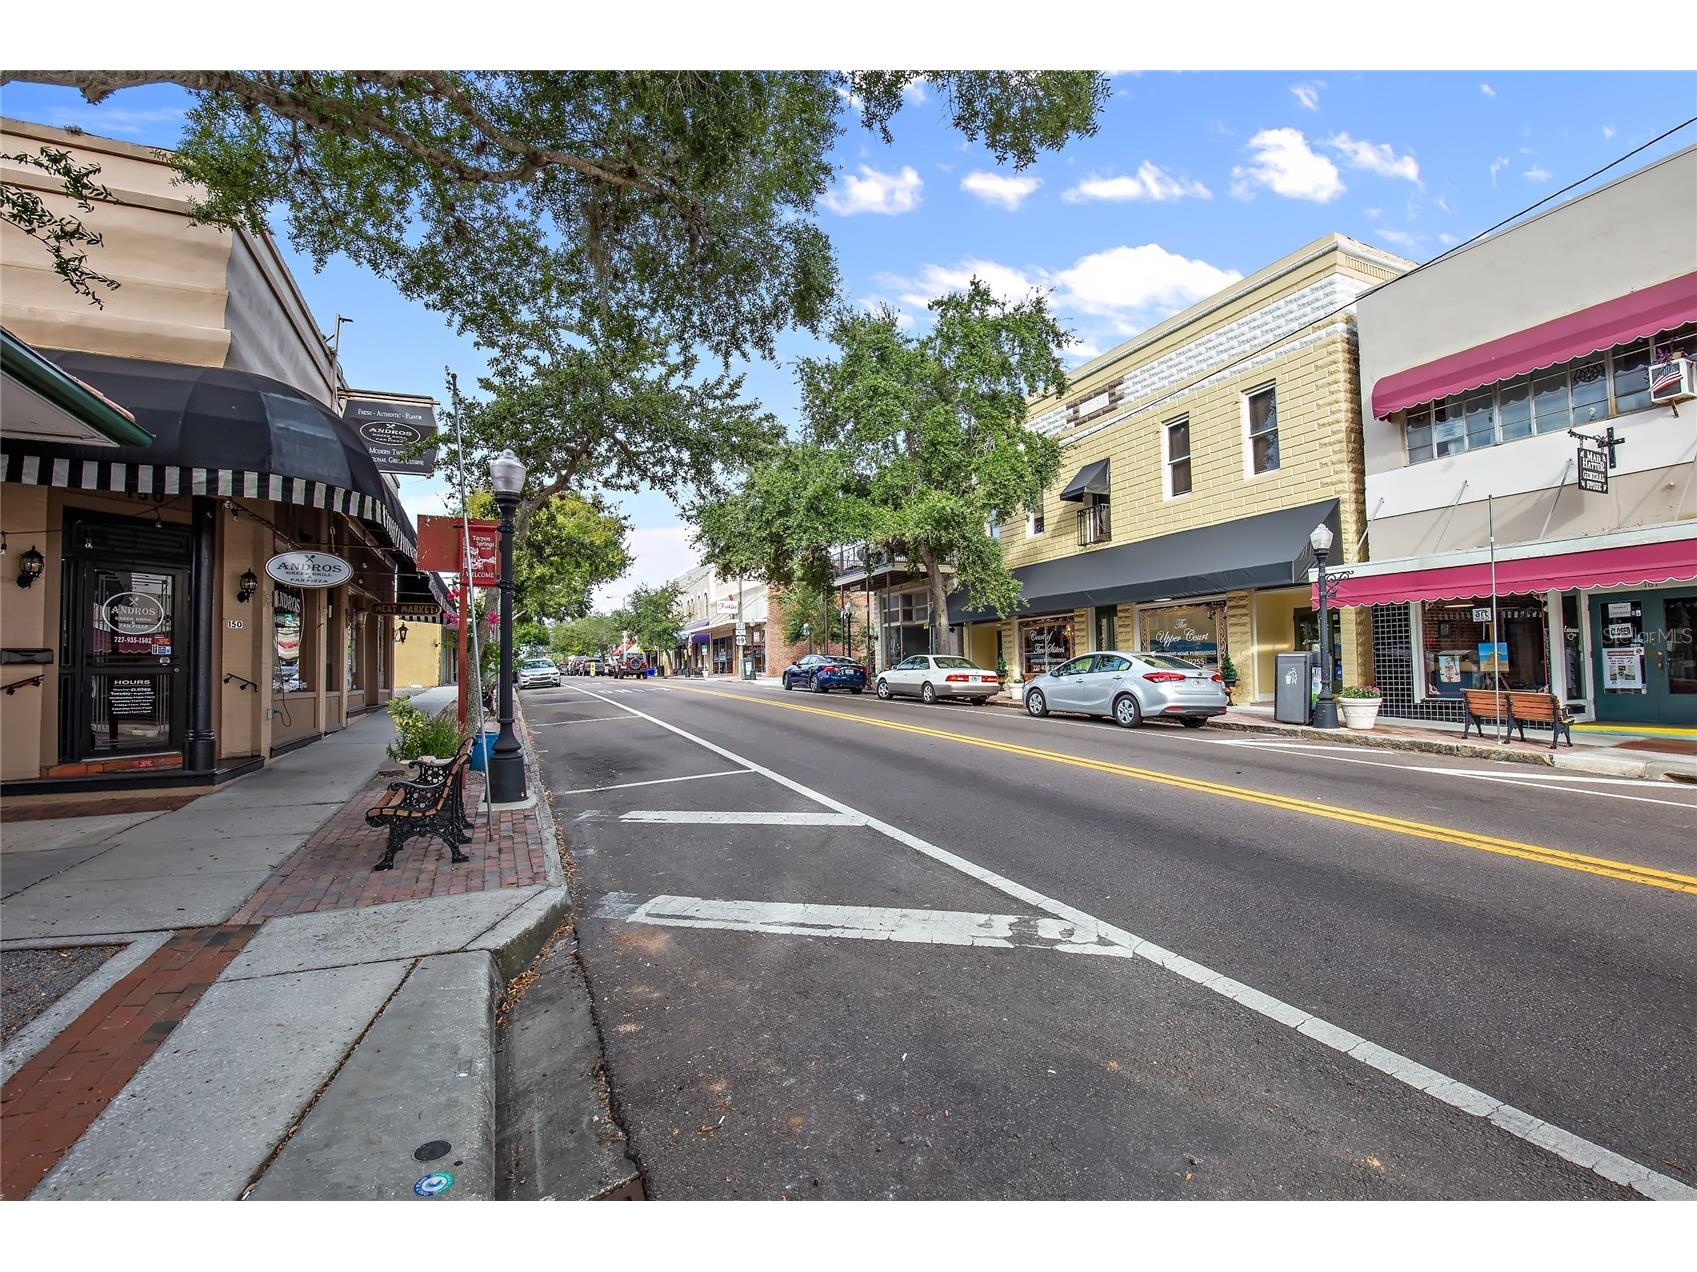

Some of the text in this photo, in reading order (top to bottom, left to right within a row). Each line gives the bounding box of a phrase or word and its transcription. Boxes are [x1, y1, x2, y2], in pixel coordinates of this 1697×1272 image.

[376, 410, 401, 419] AUTHENTIC
[368, 427, 412, 437] ANDROS
[1586, 451, 1601, 463] MAD
[1582, 457, 1605, 472] HATTER
[276, 561, 342, 573] ANDROS
[110, 606, 156, 616] ANDROS
[400, 604, 436, 614] MARKET
[1174, 618, 1188, 630] The
[114, 636, 152, 644] 727-935-1502
[1155, 627, 1209, 648] Upper Court
